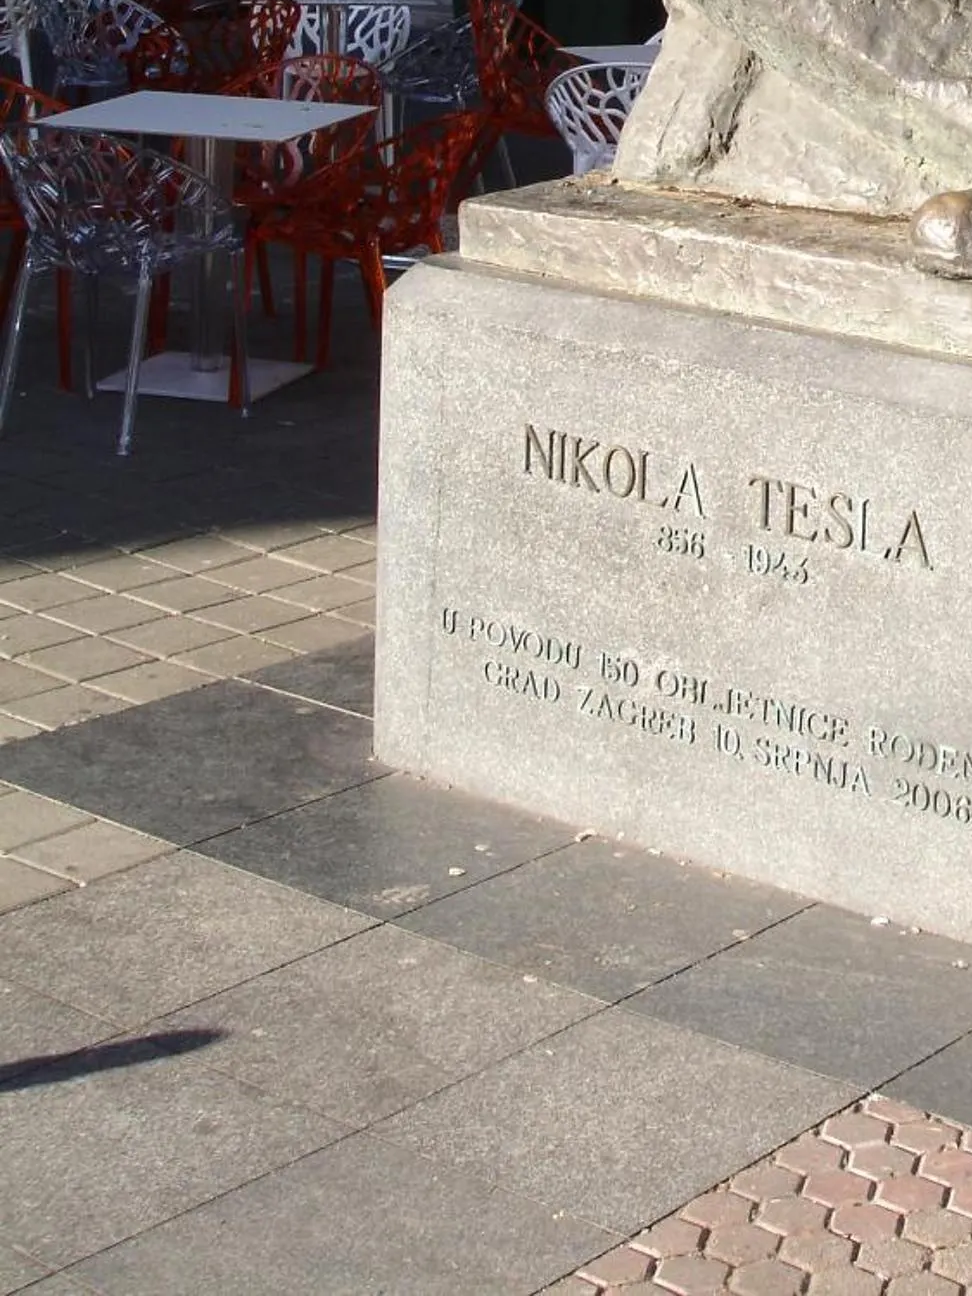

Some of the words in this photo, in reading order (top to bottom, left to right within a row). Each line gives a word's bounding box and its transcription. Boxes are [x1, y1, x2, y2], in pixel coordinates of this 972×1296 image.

[524, 423, 707, 520] NIKOLA
[749, 475, 934, 571] TESLA
[470, 617, 582, 670] POVODU
[602, 652, 640, 688] 150
[657, 669, 850, 748] OBLJETNICE
[484, 660, 561, 703] GRAD
[578, 687, 696, 745] ZAGREB
[755, 735, 872, 797] SRPNJA
